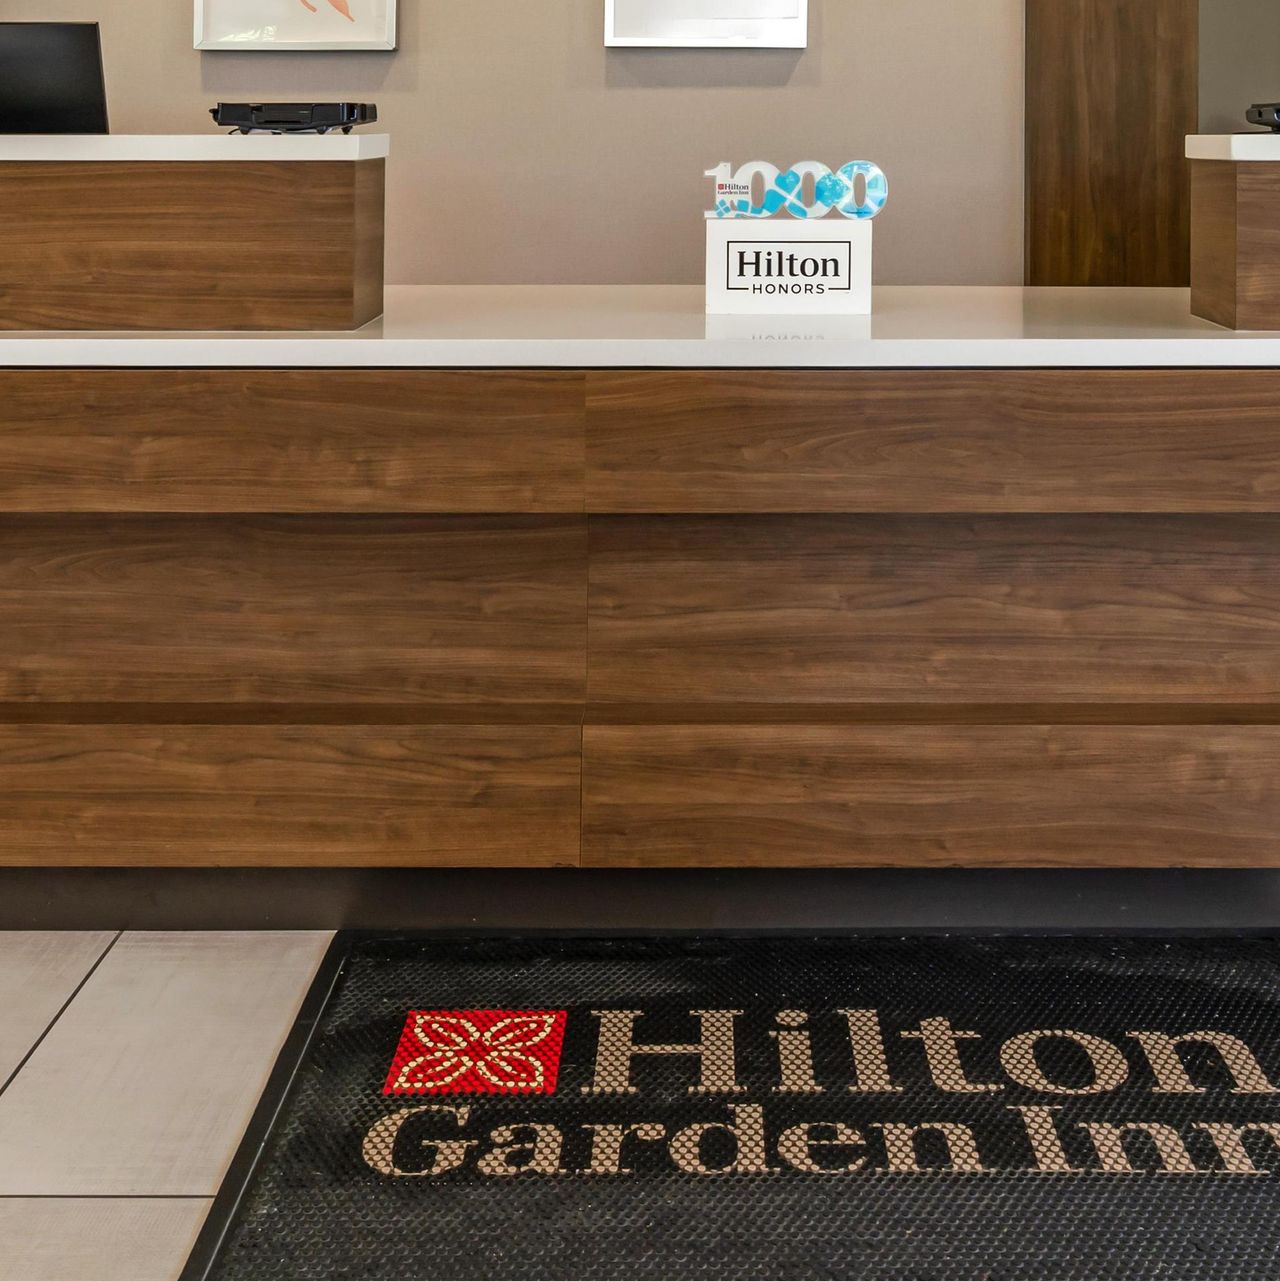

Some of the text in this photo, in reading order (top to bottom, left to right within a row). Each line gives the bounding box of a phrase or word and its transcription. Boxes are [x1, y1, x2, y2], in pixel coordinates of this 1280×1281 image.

[704, 160, 889, 220] 1000
[737, 250, 840, 278] Hilton
[752, 283, 825, 295] HONORS
[362, 1104, 988, 1175] Garden
